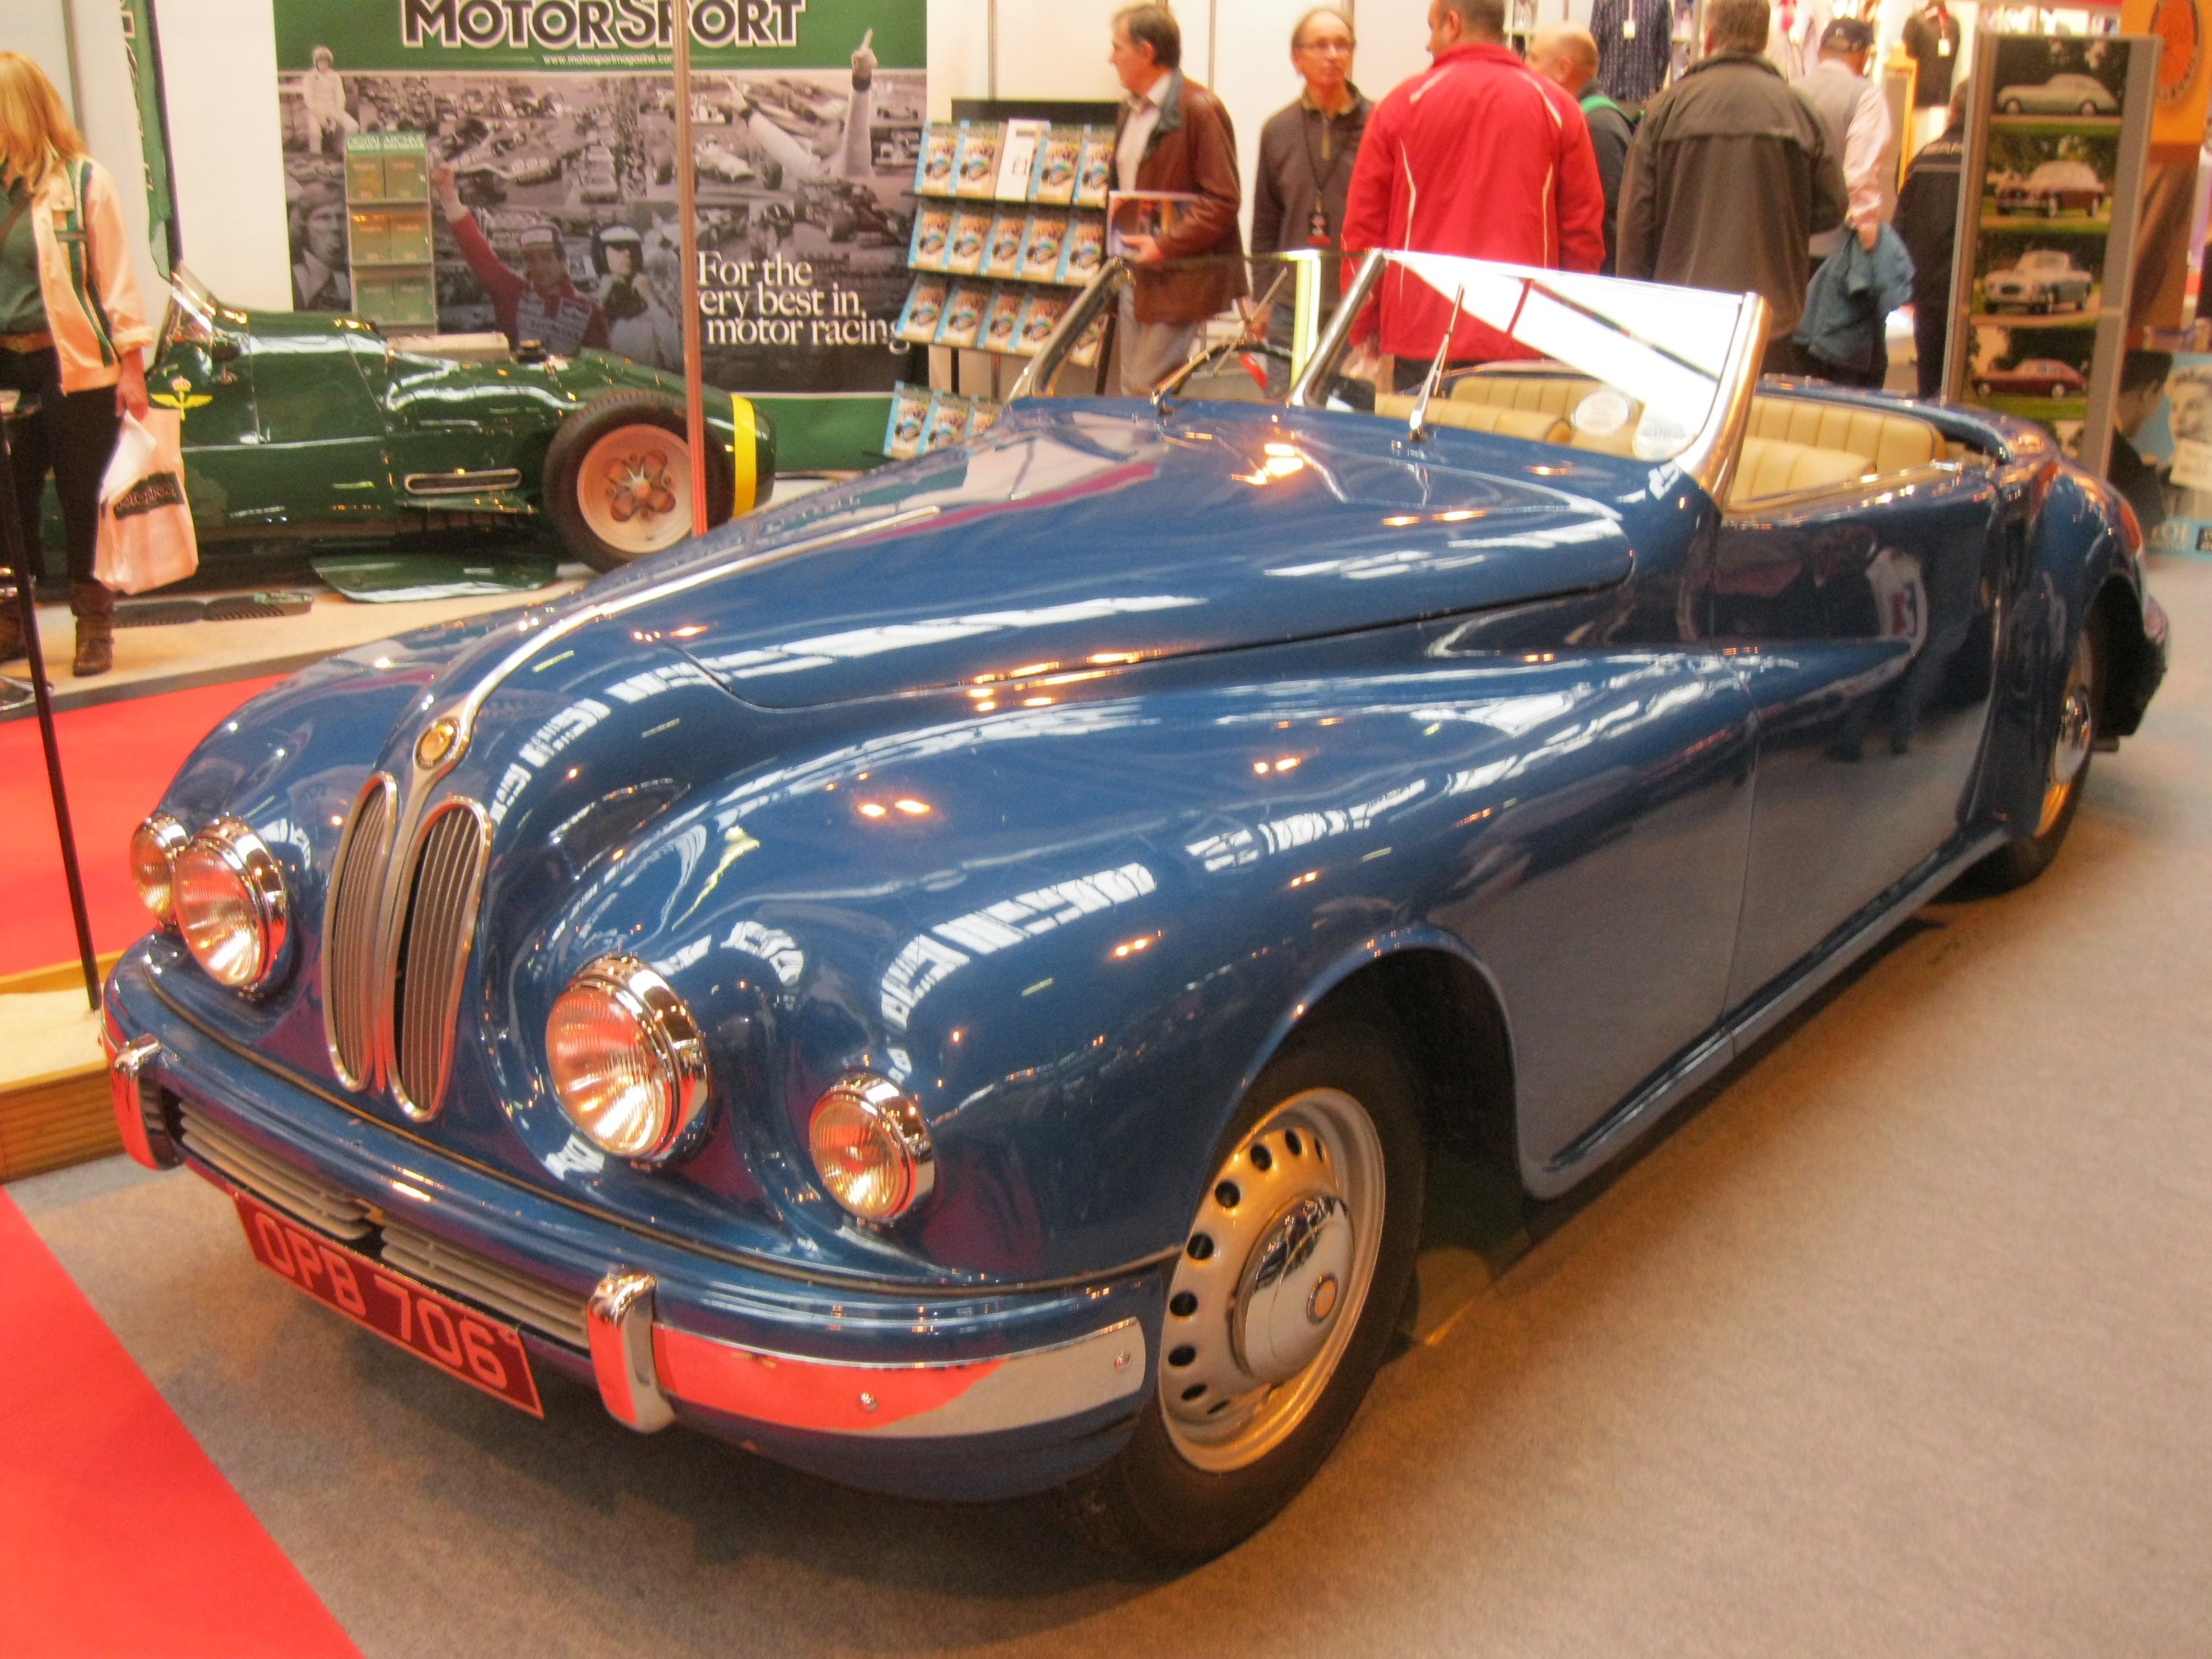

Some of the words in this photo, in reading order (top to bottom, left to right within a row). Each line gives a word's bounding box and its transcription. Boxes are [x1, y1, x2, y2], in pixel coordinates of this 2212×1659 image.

[698, 250, 755, 287] For
[762, 251, 812, 287] the
[697, 289, 749, 320] ery
[757, 281, 825, 317] best
[832, 282, 860, 317] in
[707, 317, 804, 345] motor
[255, 1211, 366, 1317] OPB
[374, 1274, 507, 1389] 706
